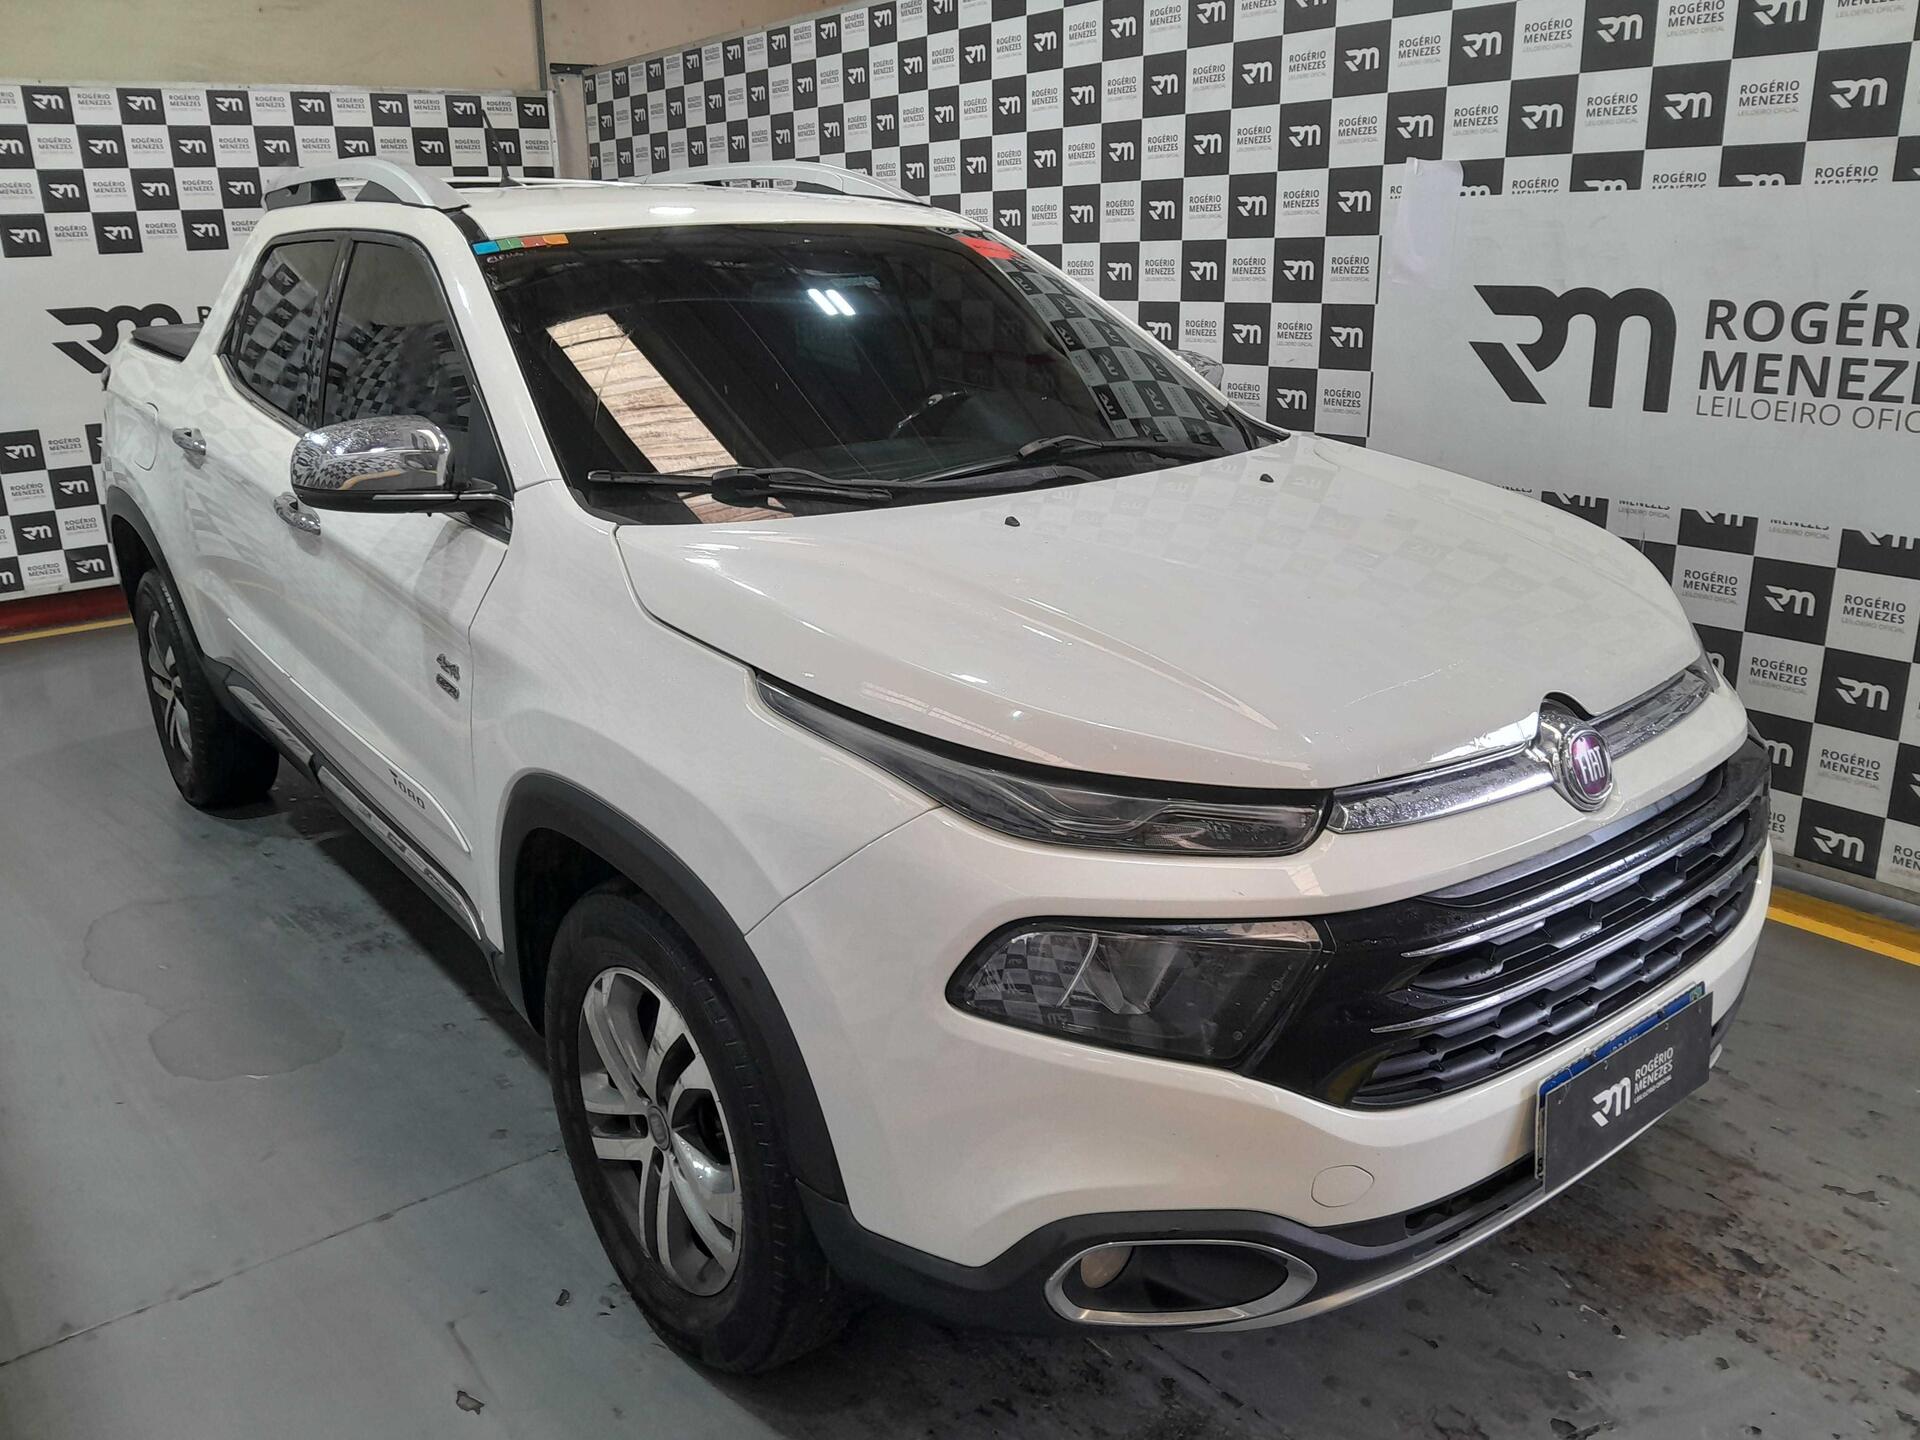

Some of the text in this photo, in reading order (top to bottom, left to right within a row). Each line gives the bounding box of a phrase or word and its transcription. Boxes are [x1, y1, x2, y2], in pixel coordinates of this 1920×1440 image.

[1150, 4, 1181, 17] ROGÉRIO
[1150, 13, 1181, 27] MENEZES
[1525, 17, 1573, 33] ROGÉRIO
[1668, 11, 1725, 27] MENEZES
[1068, 20, 1096, 32] ROGÉRIO
[1068, 28, 1096, 41] MENEZES
[1524, 28, 1572, 45] MENEZES
[1398, 34, 1441, 49] ROGÉRIO
[1289, 50, 1326, 63] ROGÉRIO
[1397, 45, 1441, 60] MENEZES
[1192, 63, 1225, 75] ROGÉRIO
[1288, 59, 1326, 73] MENEZES
[1107, 76, 1136, 87] ROGÉRIO
[1192, 72, 1225, 85] MENEZES
[1107, 84, 1136, 96] MENEZES
[1740, 79, 1800, 95] ROGÉRIO
[1587, 92, 1639, 107] ROGÉRIO
[1738, 92, 1799, 107] MENEZES
[1454, 104, 1499, 117] ROGÉRIO
[1586, 104, 1638, 119] MENEZES
[1338, 115, 1377, 127] ROGÉRIO
[1453, 115, 1499, 128] MENEZES
[1237, 125, 1271, 136] ROGÉRIO
[1337, 125, 1377, 137] MENEZES
[1147, 134, 1178, 144] ROGÉRIO
[1236, 135, 1271, 146] MENEZES
[1147, 142, 1178, 153] MENEZES
[1068, 150, 1095, 160] MENEZES
[1652, 170, 1707, 184] ROGÉRIO
[1815, 164, 1879, 178] ROGÉRIO
[1511, 176, 1560, 190] ROGÉRIO
[1189, 194, 1221, 204] ROGÉRIO
[1283, 189, 1319, 199] ROGÉRIO
[1106, 199, 1134, 208] ROGÉRIO
[1189, 203, 1221, 213] MENEZES
[1282, 199, 1319, 209] MENEZES
[1105, 208, 1134, 216] MENEZES
[1145, 258, 1174, 266] ROGÉRIO
[1232, 256, 1265, 265] ROGÉRIO
[1331, 255, 1369, 265] ROGÉRIO
[1144, 267, 1174, 275] MENEZES
[1232, 266, 1266, 274] MENEZES
[1331, 266, 1369, 274] MENEZES
[1185, 319, 1216, 328] ROGÉRIO
[1277, 321, 1312, 330] ROGÉRIO
[1185, 328, 1216, 336] MENEZES
[1277, 330, 1312, 340] MENEZES
[1227, 382, 1259, 392] ROGÉRIO
[1323, 388, 1360, 398] ROGÉRIO
[1227, 391, 1259, 401] MENEZES
[1323, 397, 1360, 408] MENEZES
[1696, 395, 1920, 433] LEILOEIRO OFIC
[1684, 569, 1738, 586] ROGÉRIO
[1683, 579, 1737, 597] MENEZES
[1844, 594, 1907, 613] ROGÉRIO
[1842, 605, 1906, 625] MENEZES
[1751, 656, 1808, 676] ROGÉRIO
[1750, 666, 1808, 687] MENEZES
[1574, 745, 1606, 784] FIAT
[1821, 748, 1882, 771] ROGÉRIO
[1819, 758, 1881, 782] MENEZES
[1634, 1047, 1674, 1081] ROGÉRIO
[1634, 1059, 1673, 1094] MENEZES
